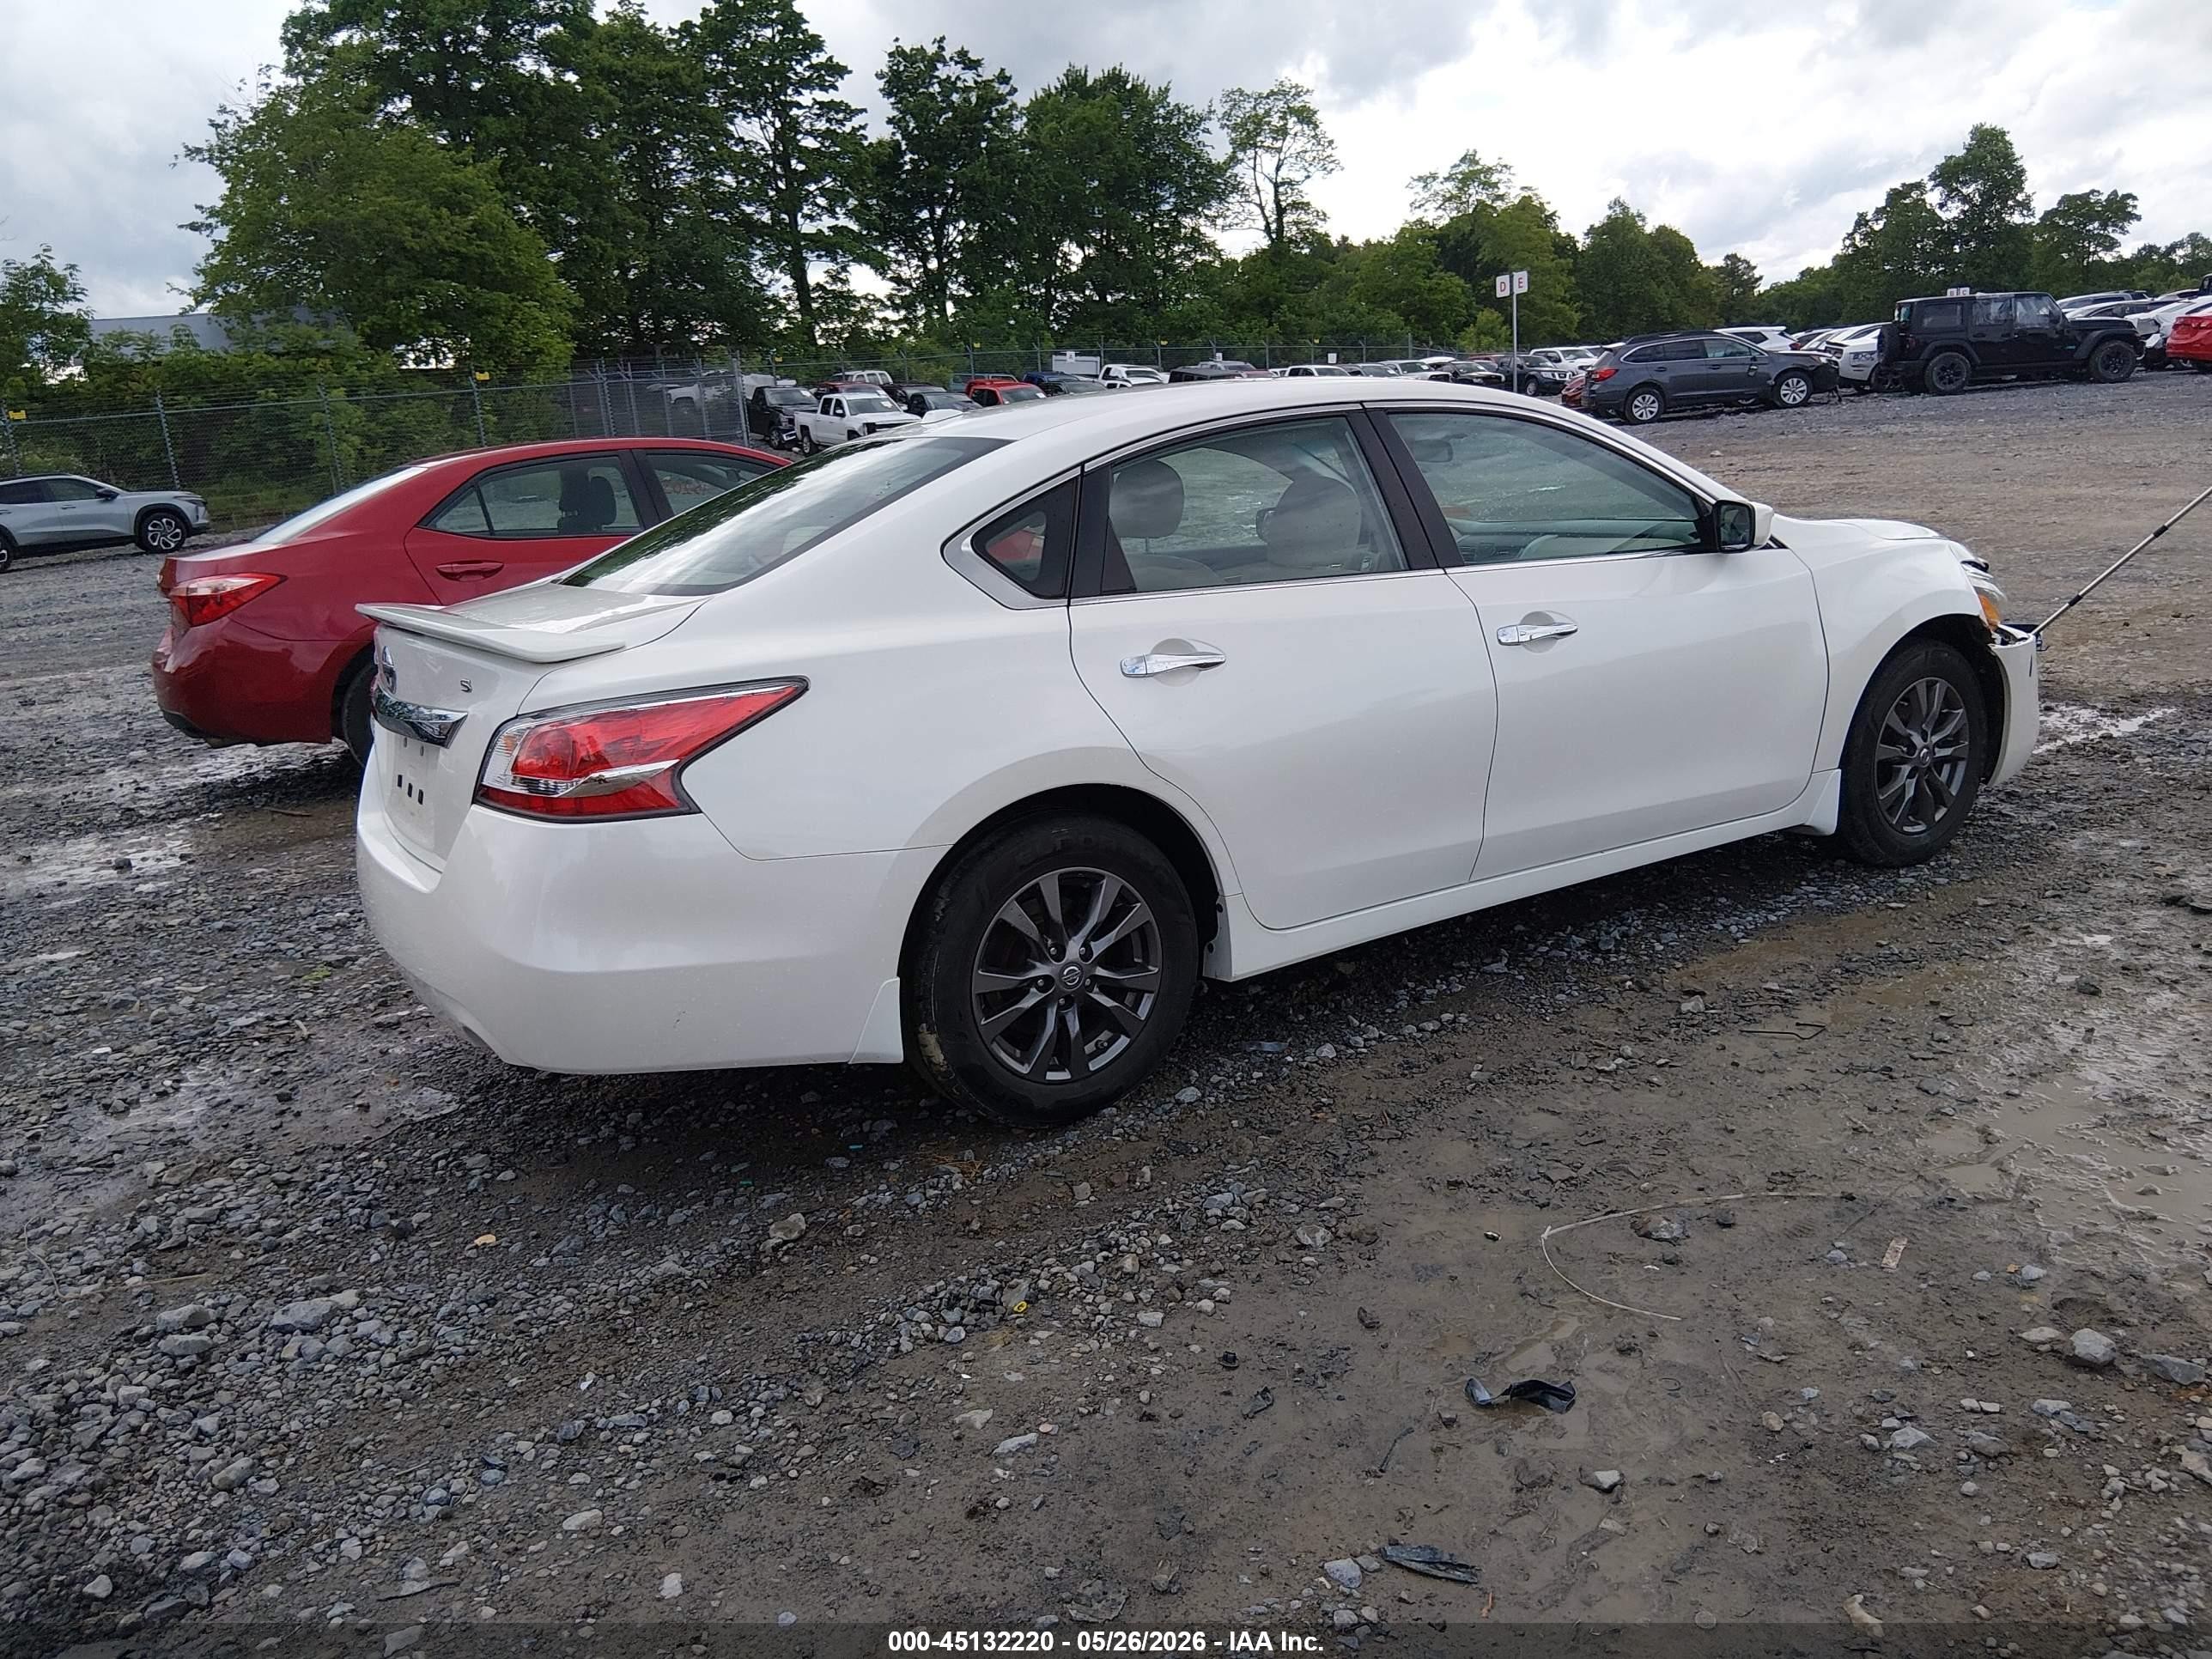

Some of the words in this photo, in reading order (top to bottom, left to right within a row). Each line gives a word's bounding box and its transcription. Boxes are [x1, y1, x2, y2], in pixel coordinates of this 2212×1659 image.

[1499, 281, 1506, 292] D
[1517, 277, 1523, 289] E
[460, 678, 472, 693] S
